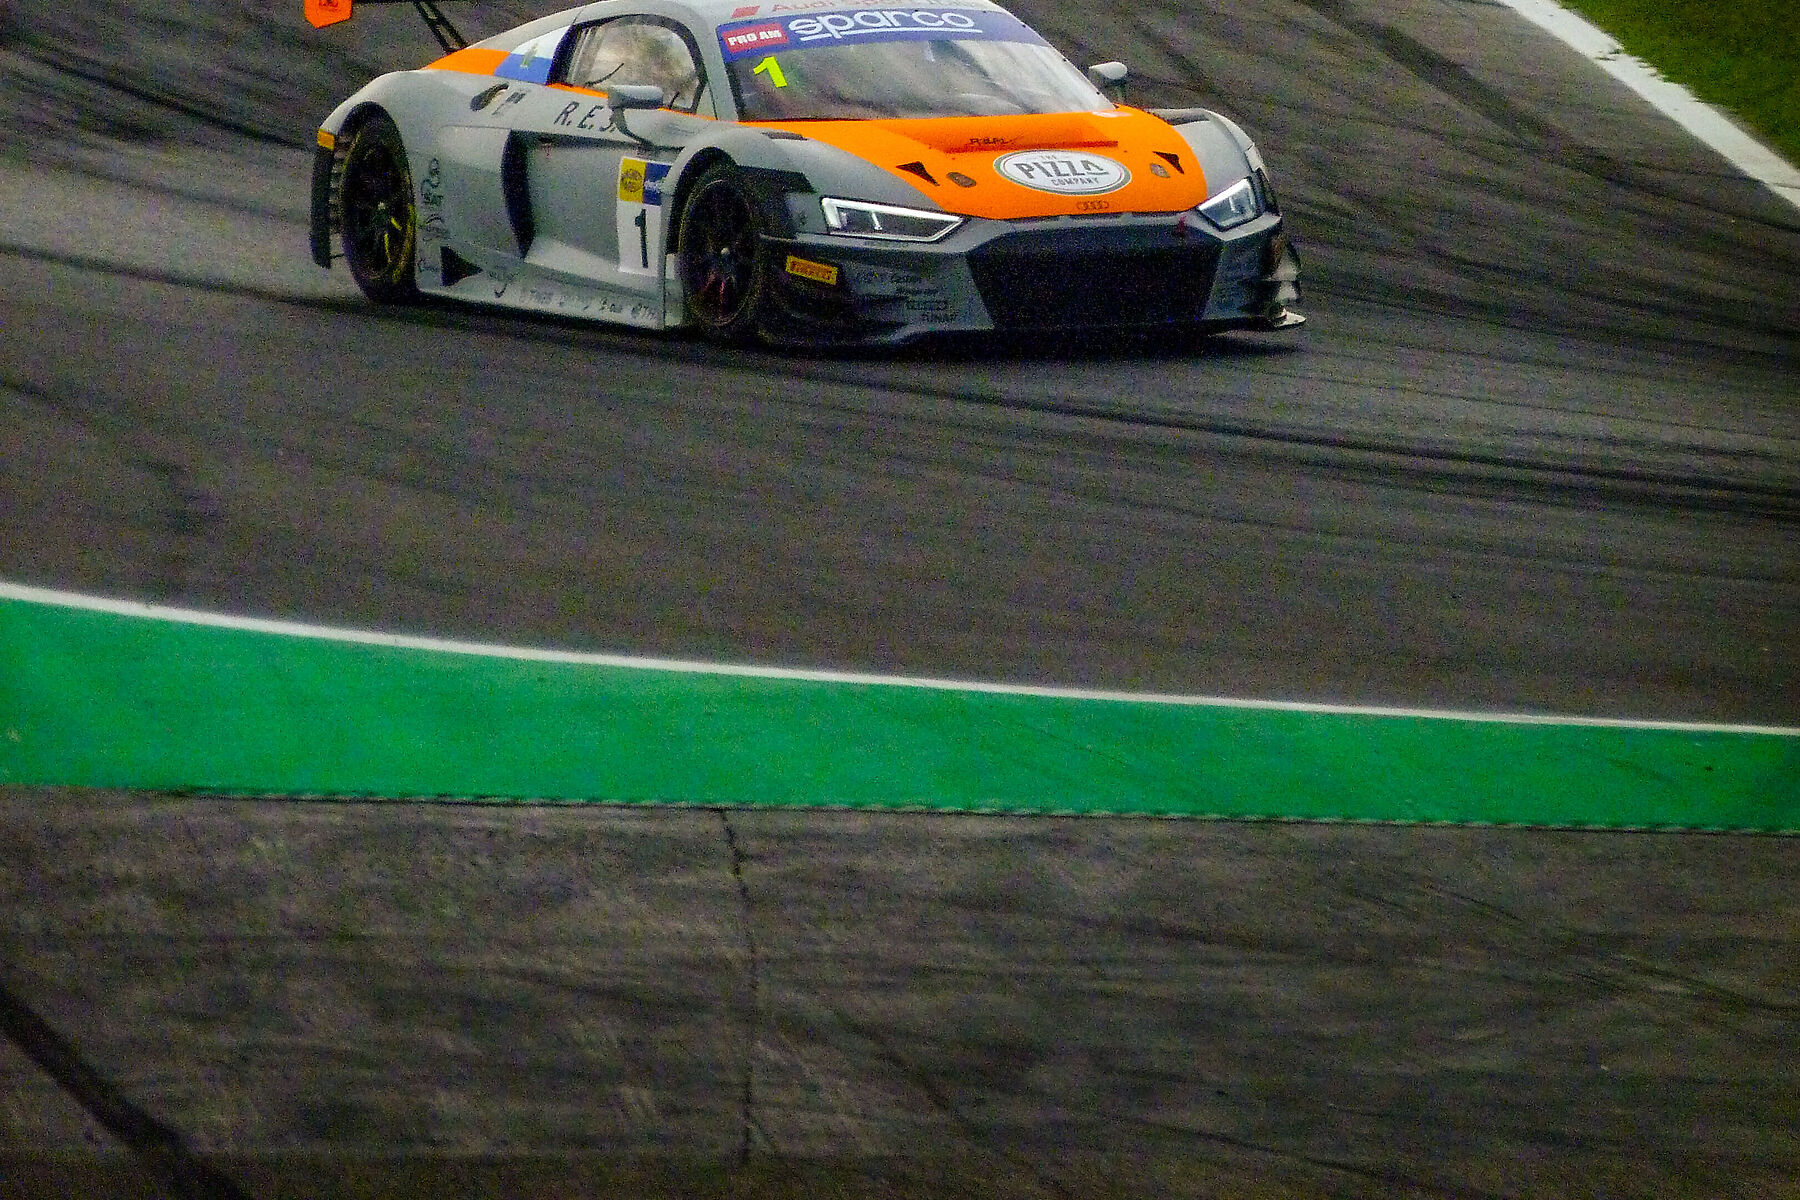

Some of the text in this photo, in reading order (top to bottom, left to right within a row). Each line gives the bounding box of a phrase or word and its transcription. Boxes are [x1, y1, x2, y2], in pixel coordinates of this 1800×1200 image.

[772, 0, 835, 12] Audi
[789, 10, 975, 40] sparco
[728, 29, 782, 47] PRO AM
[753, 56, 788, 89] 1
[1014, 159, 1110, 179] PIZZA
[1051, 177, 1098, 186] COMPANY
[634, 208, 649, 269] 1
